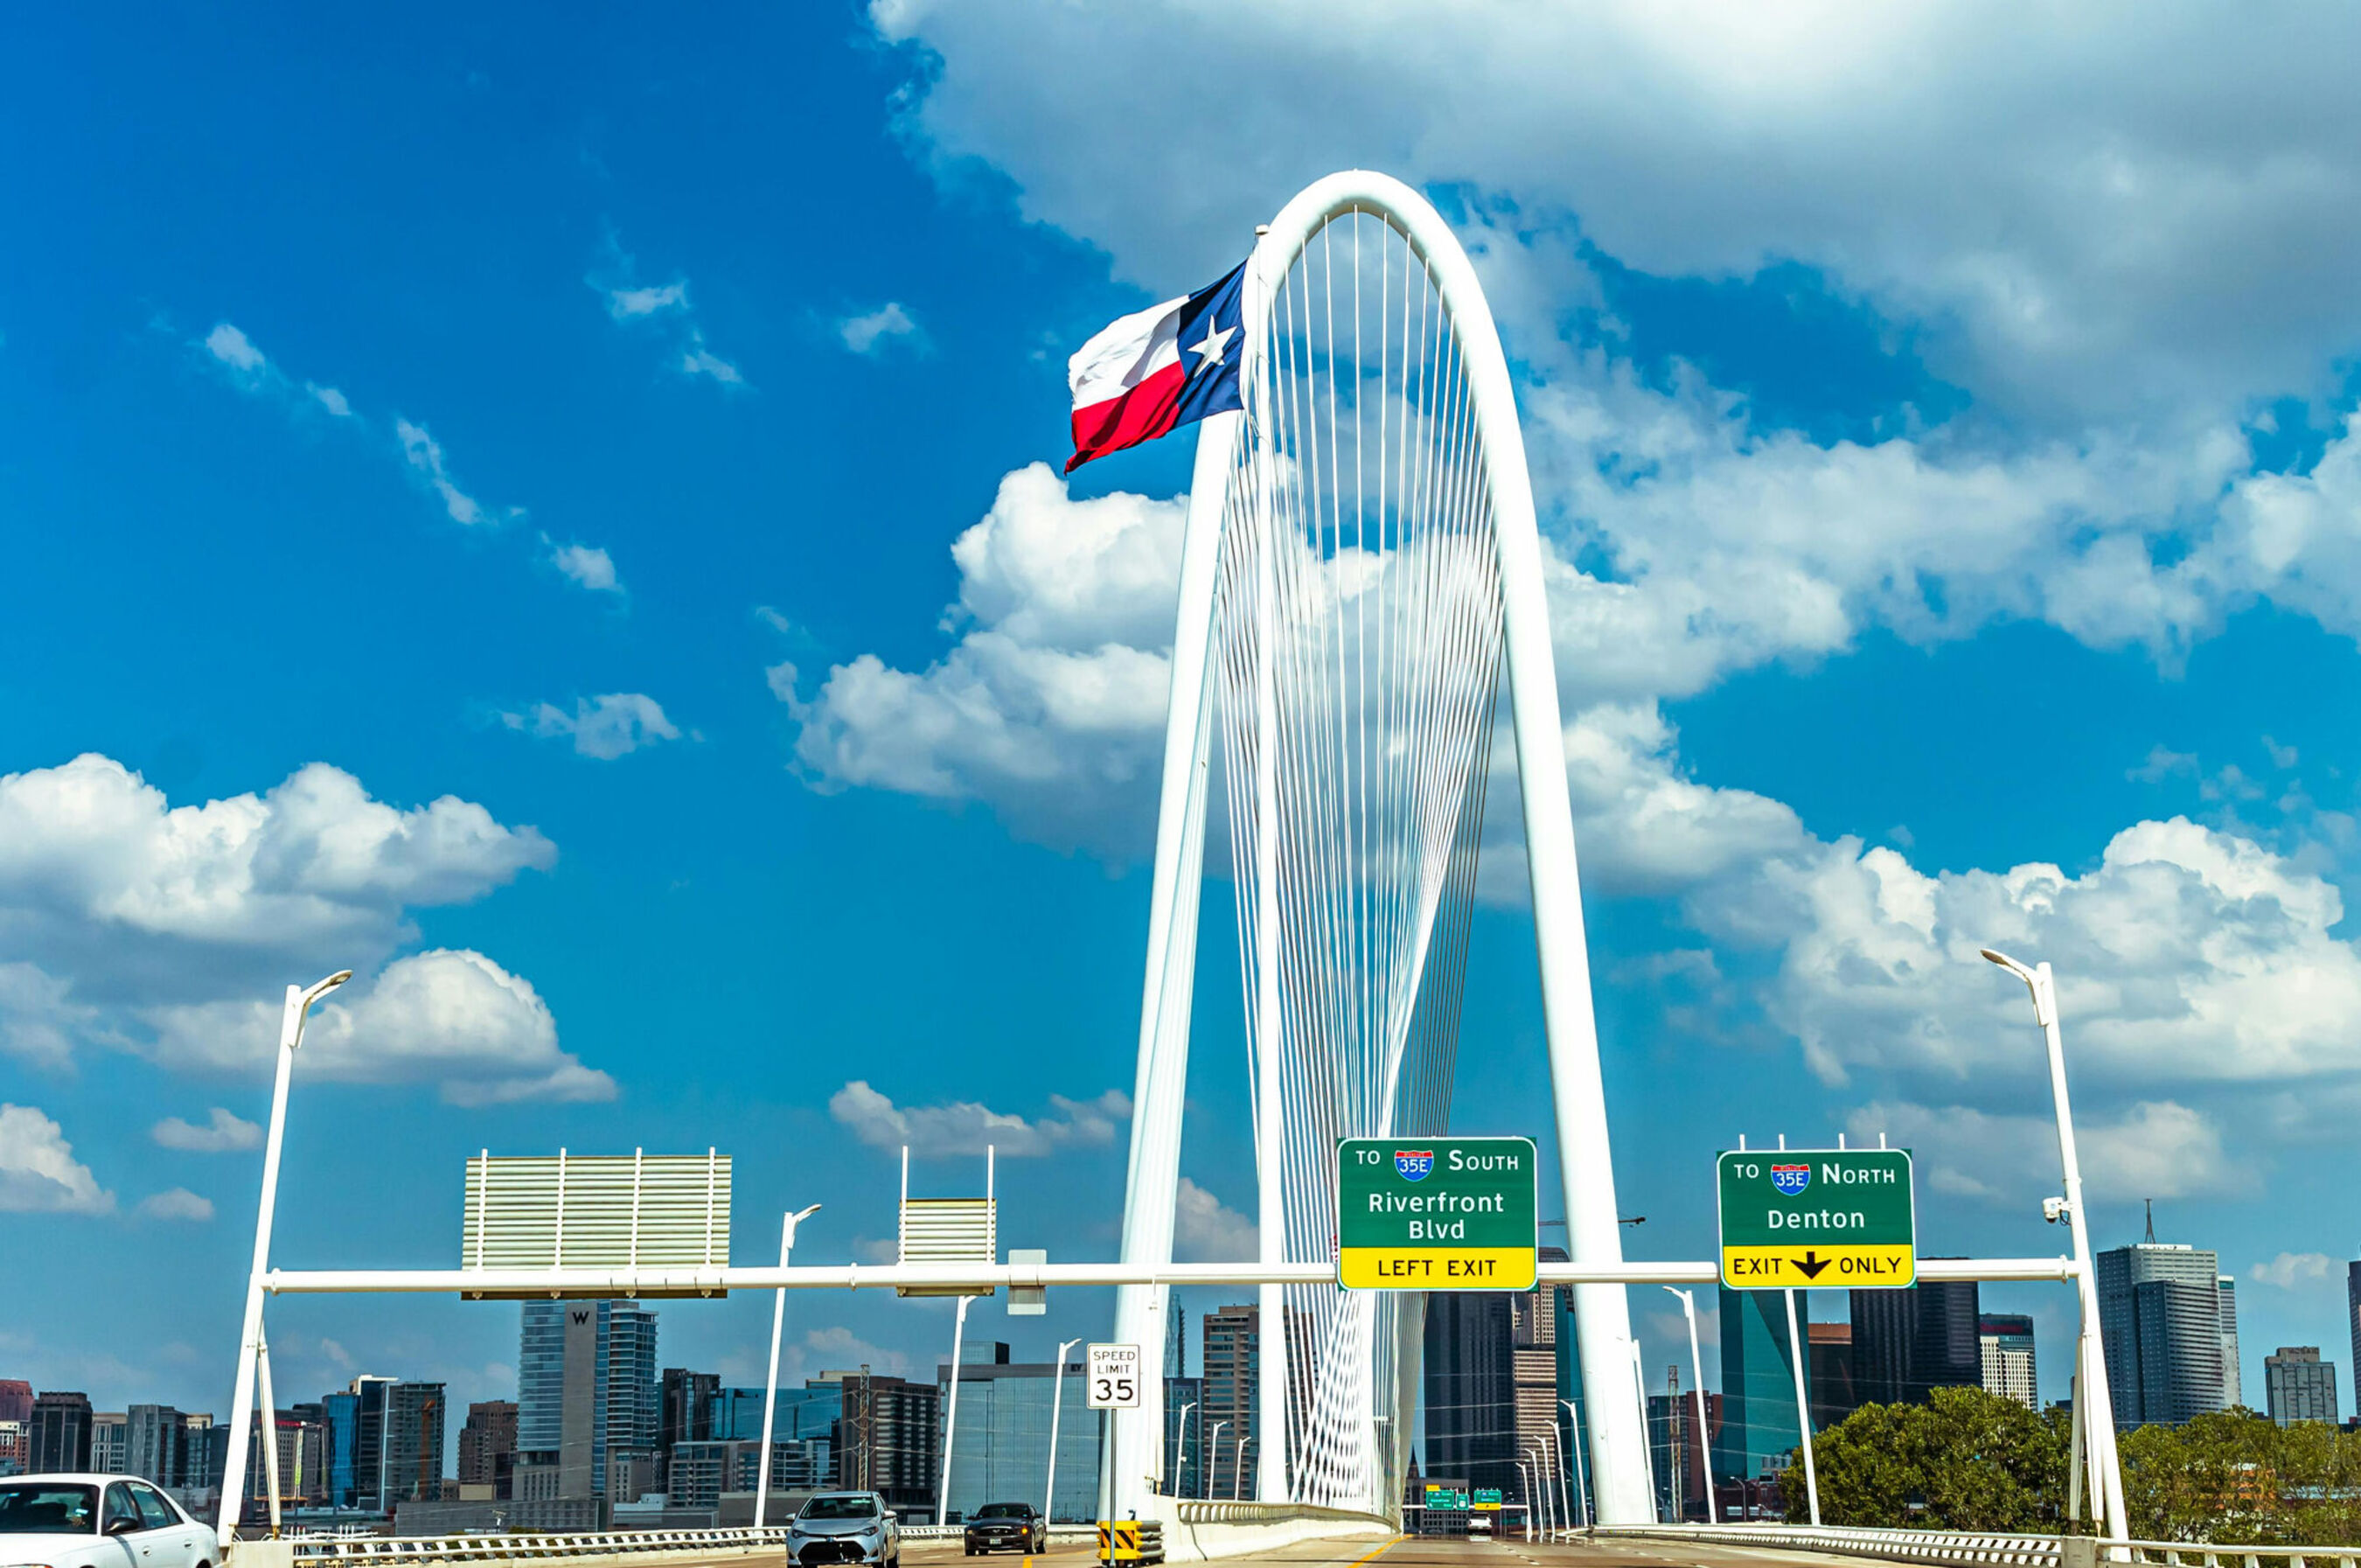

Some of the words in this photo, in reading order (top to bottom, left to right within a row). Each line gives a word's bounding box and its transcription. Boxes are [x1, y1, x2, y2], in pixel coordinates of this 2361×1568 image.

[1355, 1150, 1381, 1165] TO
[1399, 1159, 1429, 1173] 35E
[1448, 1149, 1519, 1171] SOUTH
[1734, 1164, 1759, 1179] TO
[1776, 1173, 1806, 1187] 35E
[1822, 1163, 1895, 1184] NORTH
[1369, 1191, 1504, 1213] Riverfront
[1409, 1219, 1465, 1239] Blvd
[1767, 1209, 1865, 1229] Denton
[1378, 1259, 1433, 1276] LEFT
[1448, 1259, 1497, 1276] EXIT
[1733, 1258, 1783, 1275] EXIT
[1840, 1257, 1901, 1274] ONLY
[573, 1311, 589, 1325] W
[1093, 1350, 1136, 1361] SPEED
[1097, 1364, 1131, 1374] LIMIT
[1095, 1378, 1134, 1402] 35
